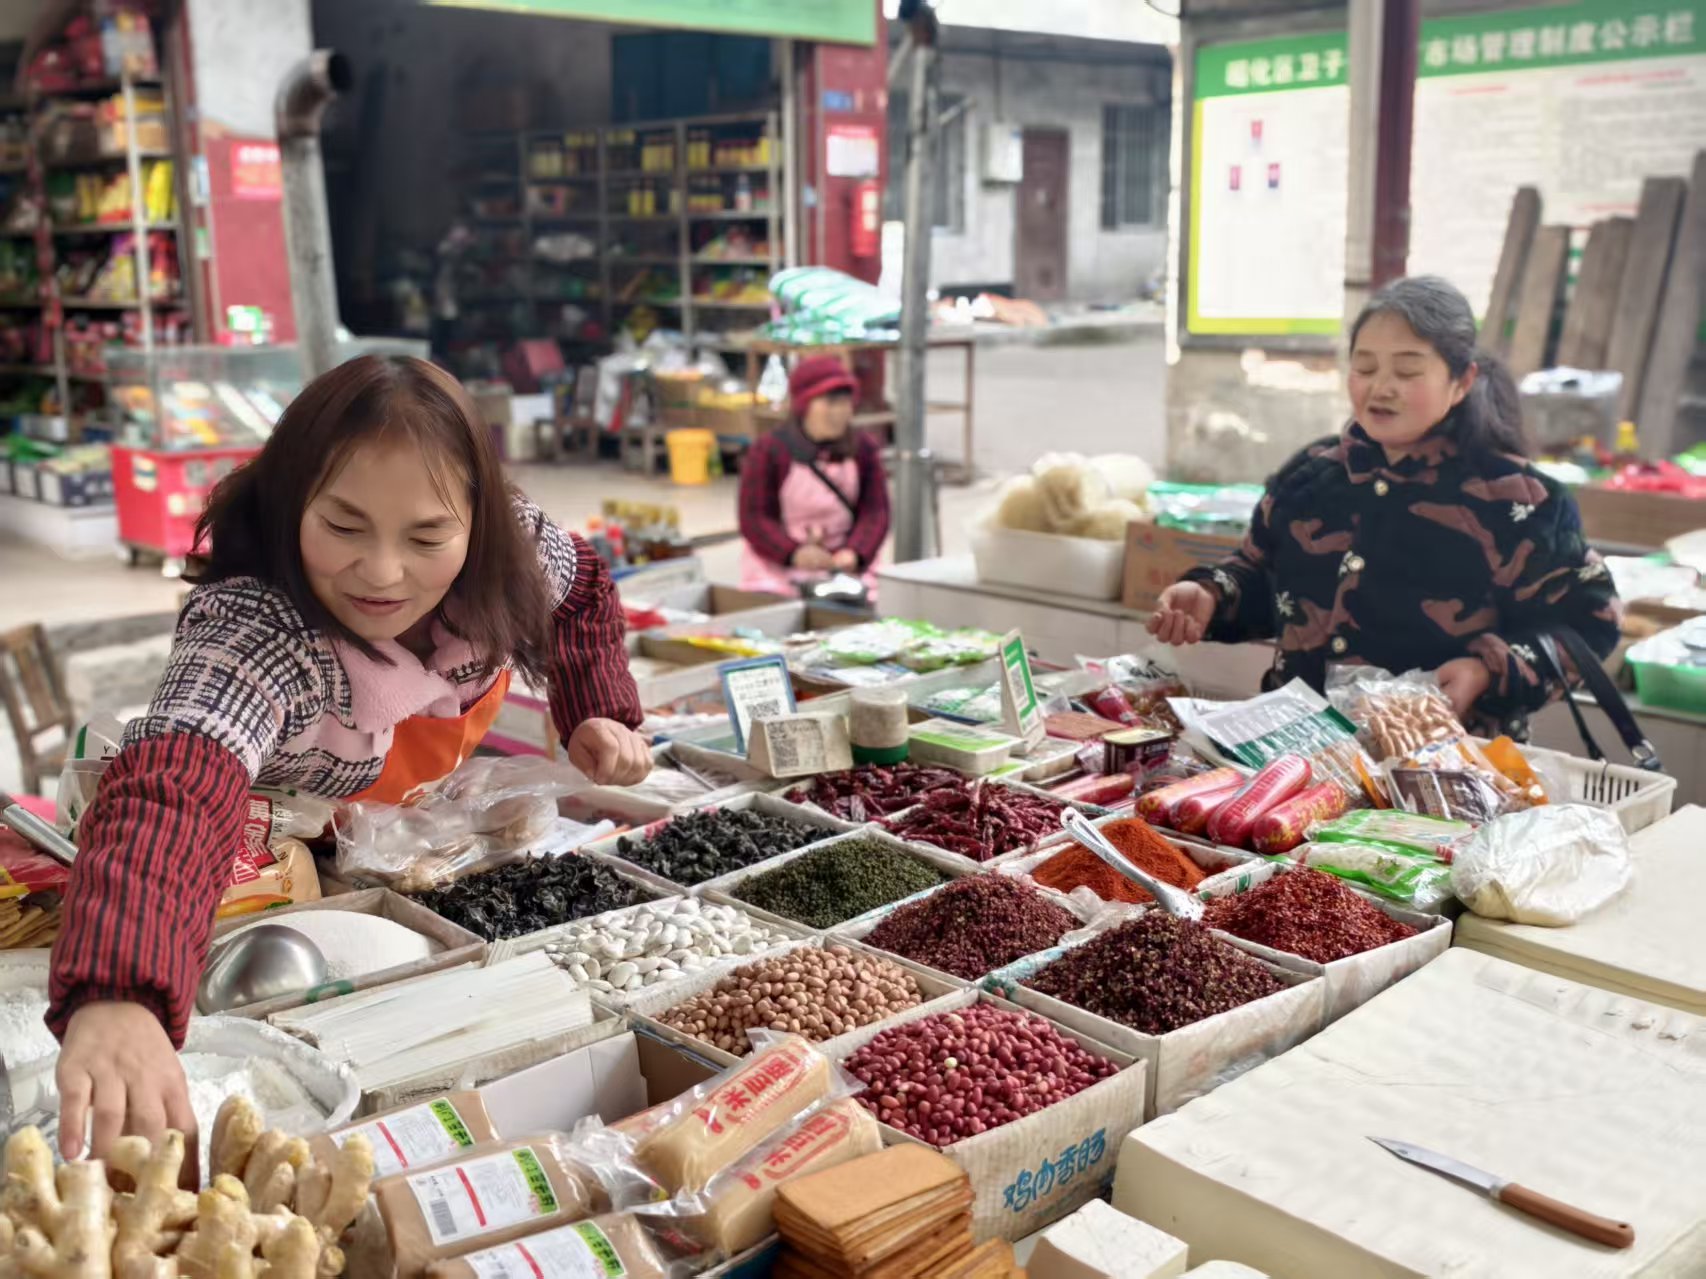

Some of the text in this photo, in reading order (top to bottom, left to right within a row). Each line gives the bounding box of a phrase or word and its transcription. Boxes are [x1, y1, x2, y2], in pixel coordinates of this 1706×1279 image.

[1424, 10, 1696, 68] 市场管理制度公示栏
[1003, 1127, 1106, 1213] 鸡肉香肠
